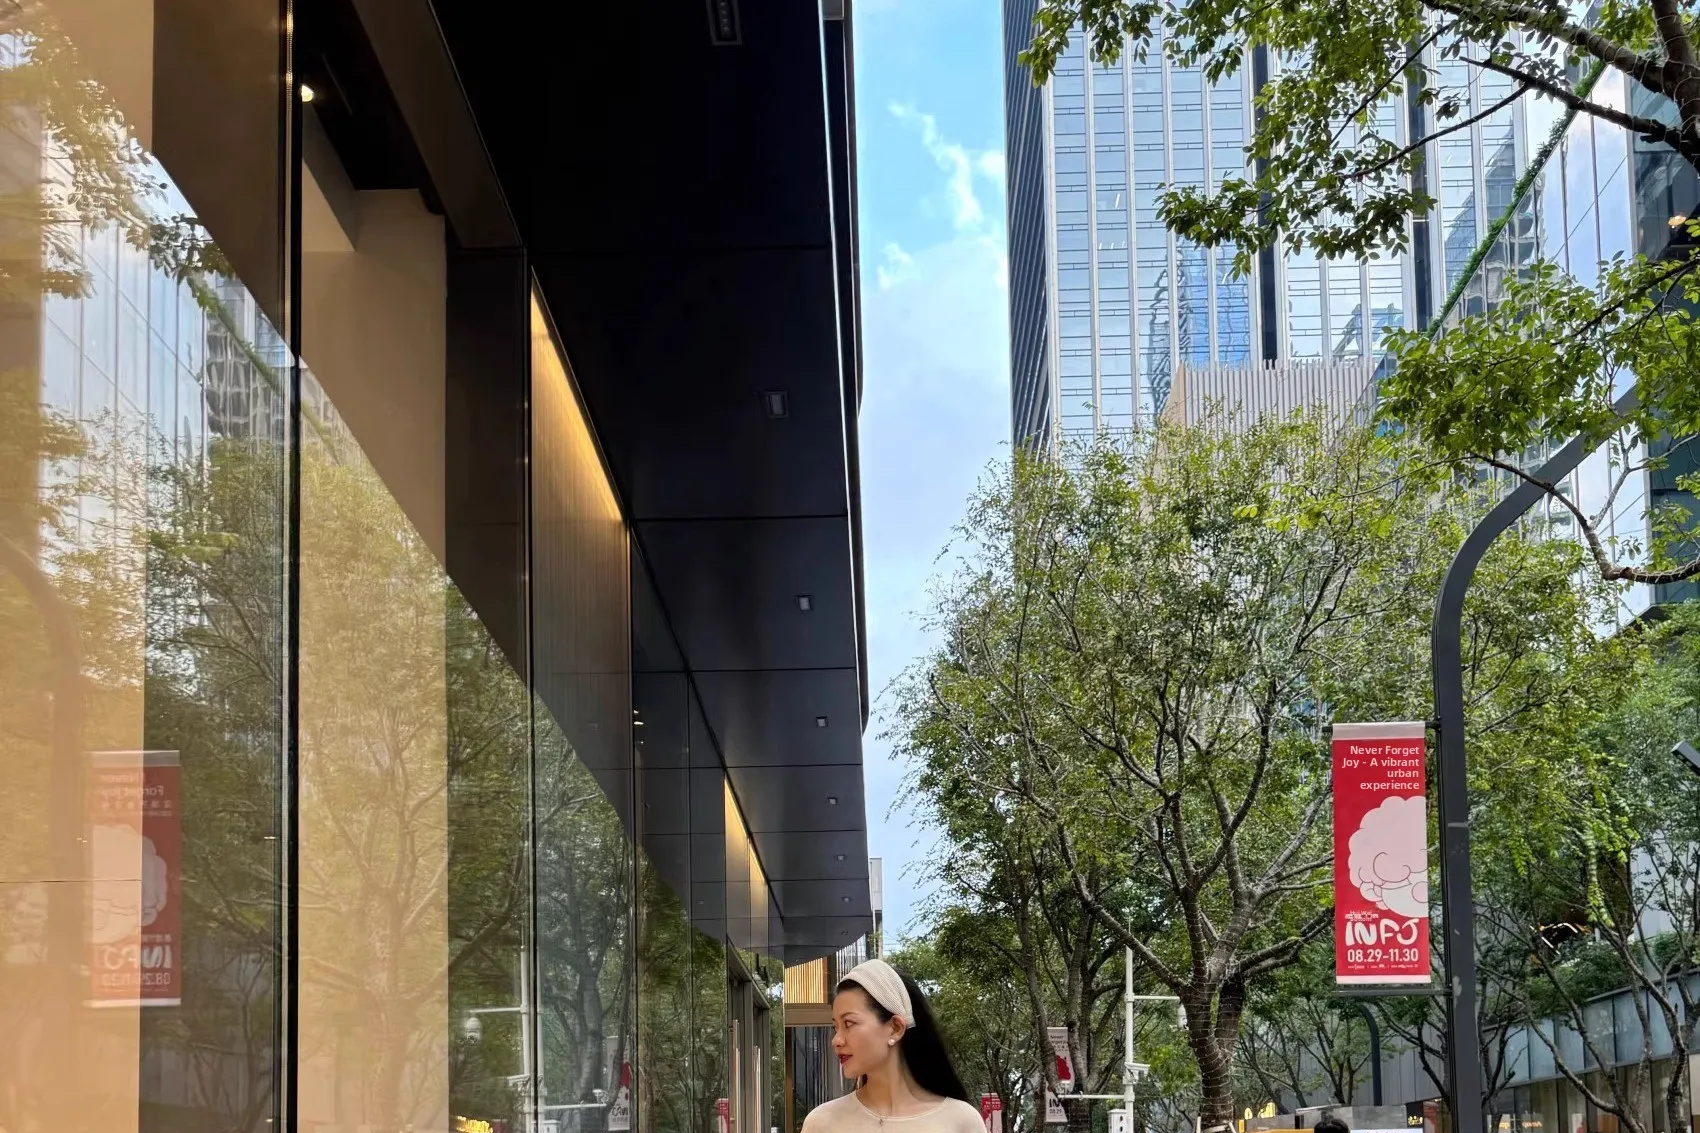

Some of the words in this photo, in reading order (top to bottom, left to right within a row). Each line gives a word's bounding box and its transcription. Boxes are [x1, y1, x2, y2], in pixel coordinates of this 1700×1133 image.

[1350, 745, 1383, 755] Never
[1385, 745, 1420, 757] Forget
[1341, 757, 1360, 769] Joy
[1369, 757, 1379, 767] A
[1381, 756, 1420, 767] vibrant
[1387, 768, 1419, 778] urban
[1360, 779, 1420, 792] experience
[1345, 918, 1420, 946] INFJ
[1347, 948, 1419, 963] 08.29-11.30
